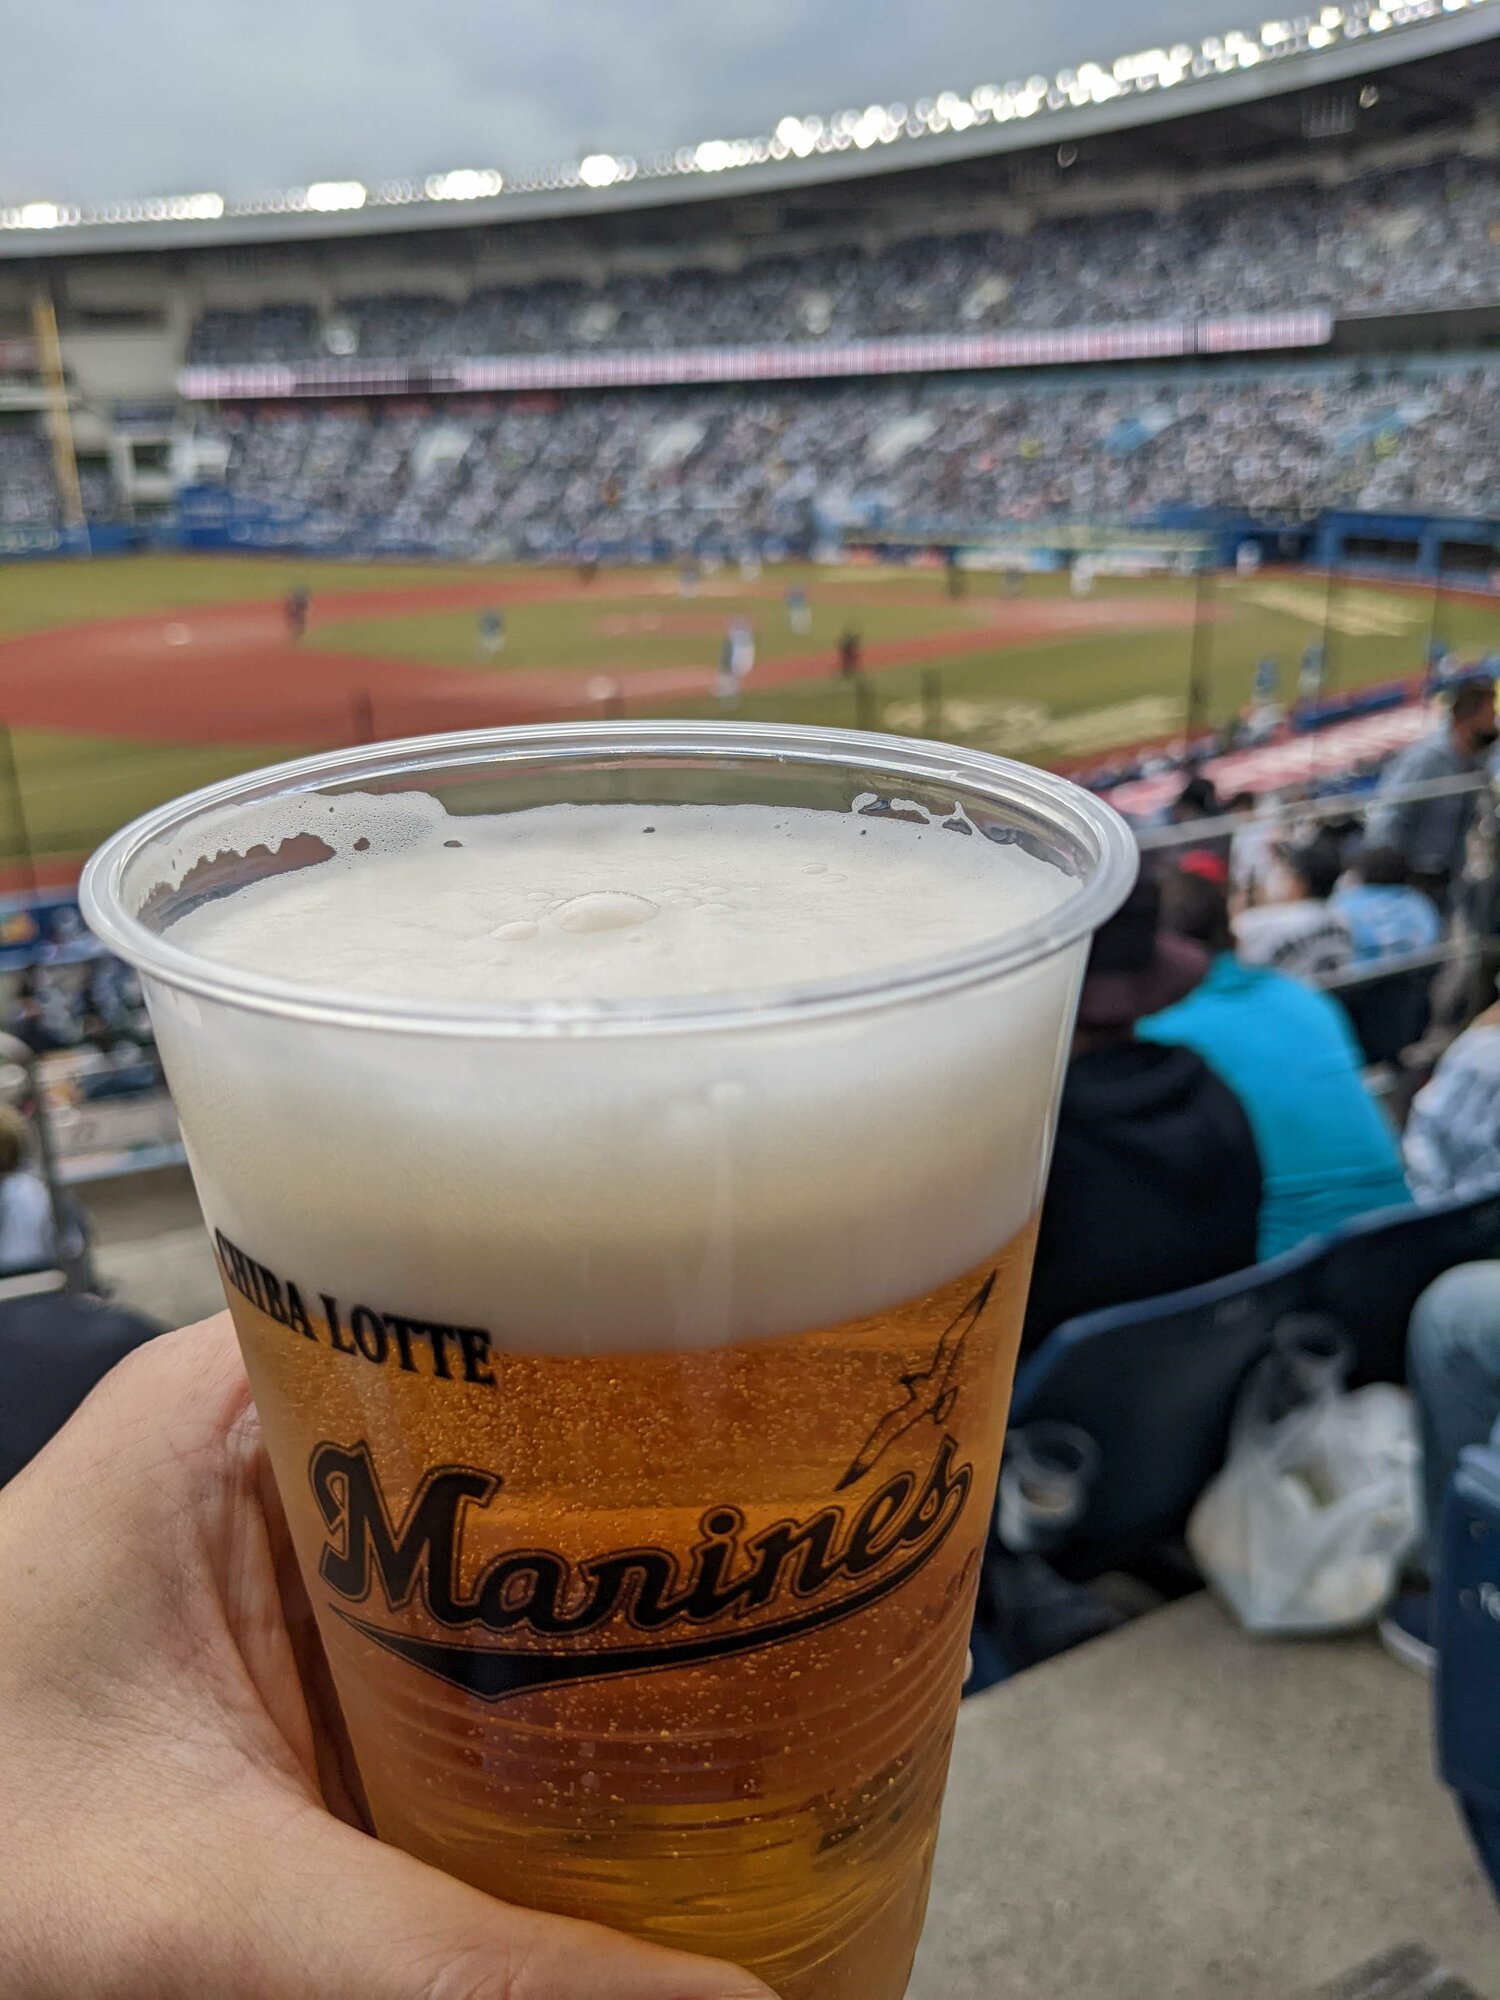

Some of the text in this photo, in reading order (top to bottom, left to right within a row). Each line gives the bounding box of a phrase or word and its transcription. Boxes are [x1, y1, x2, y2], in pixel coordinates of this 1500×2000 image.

[214, 1226, 496, 1386] CHIBA LOTTE
[309, 1434, 974, 1638] Marines
